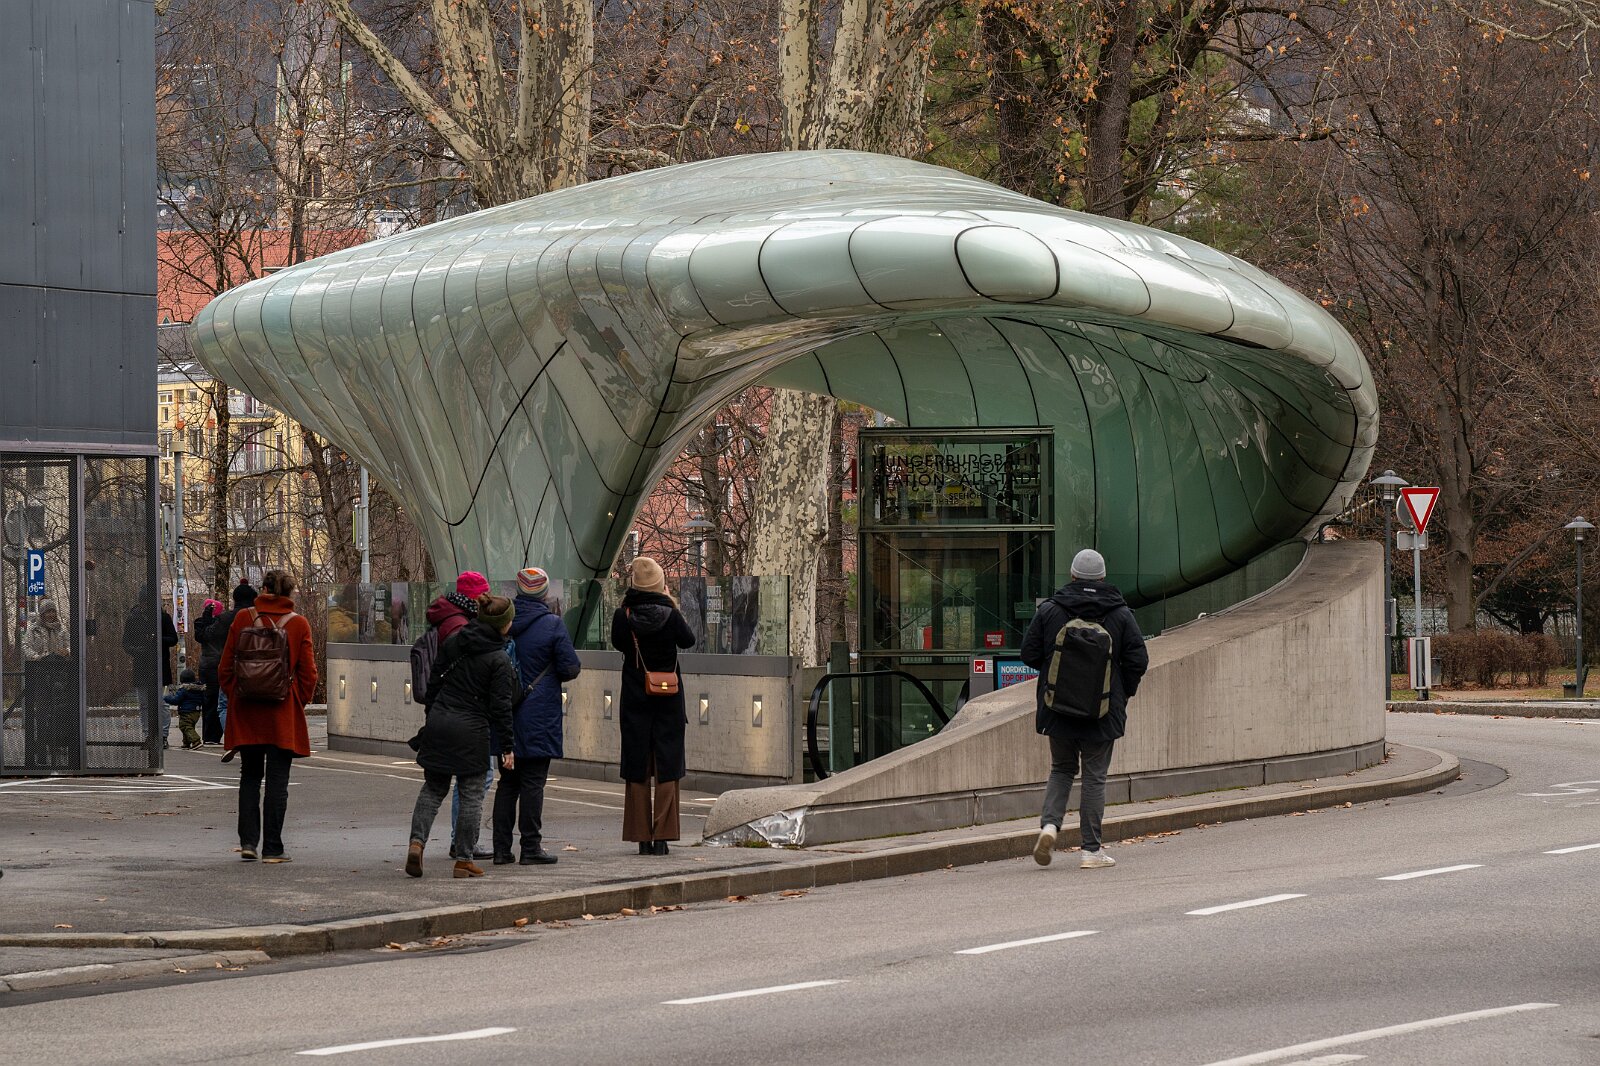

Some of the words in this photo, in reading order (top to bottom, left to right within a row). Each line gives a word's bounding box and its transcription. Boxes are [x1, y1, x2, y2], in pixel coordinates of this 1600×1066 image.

[873, 474, 944, 486] STATION
[959, 472, 1041, 485] ALTSTADT
[30, 553, 43, 580] P
